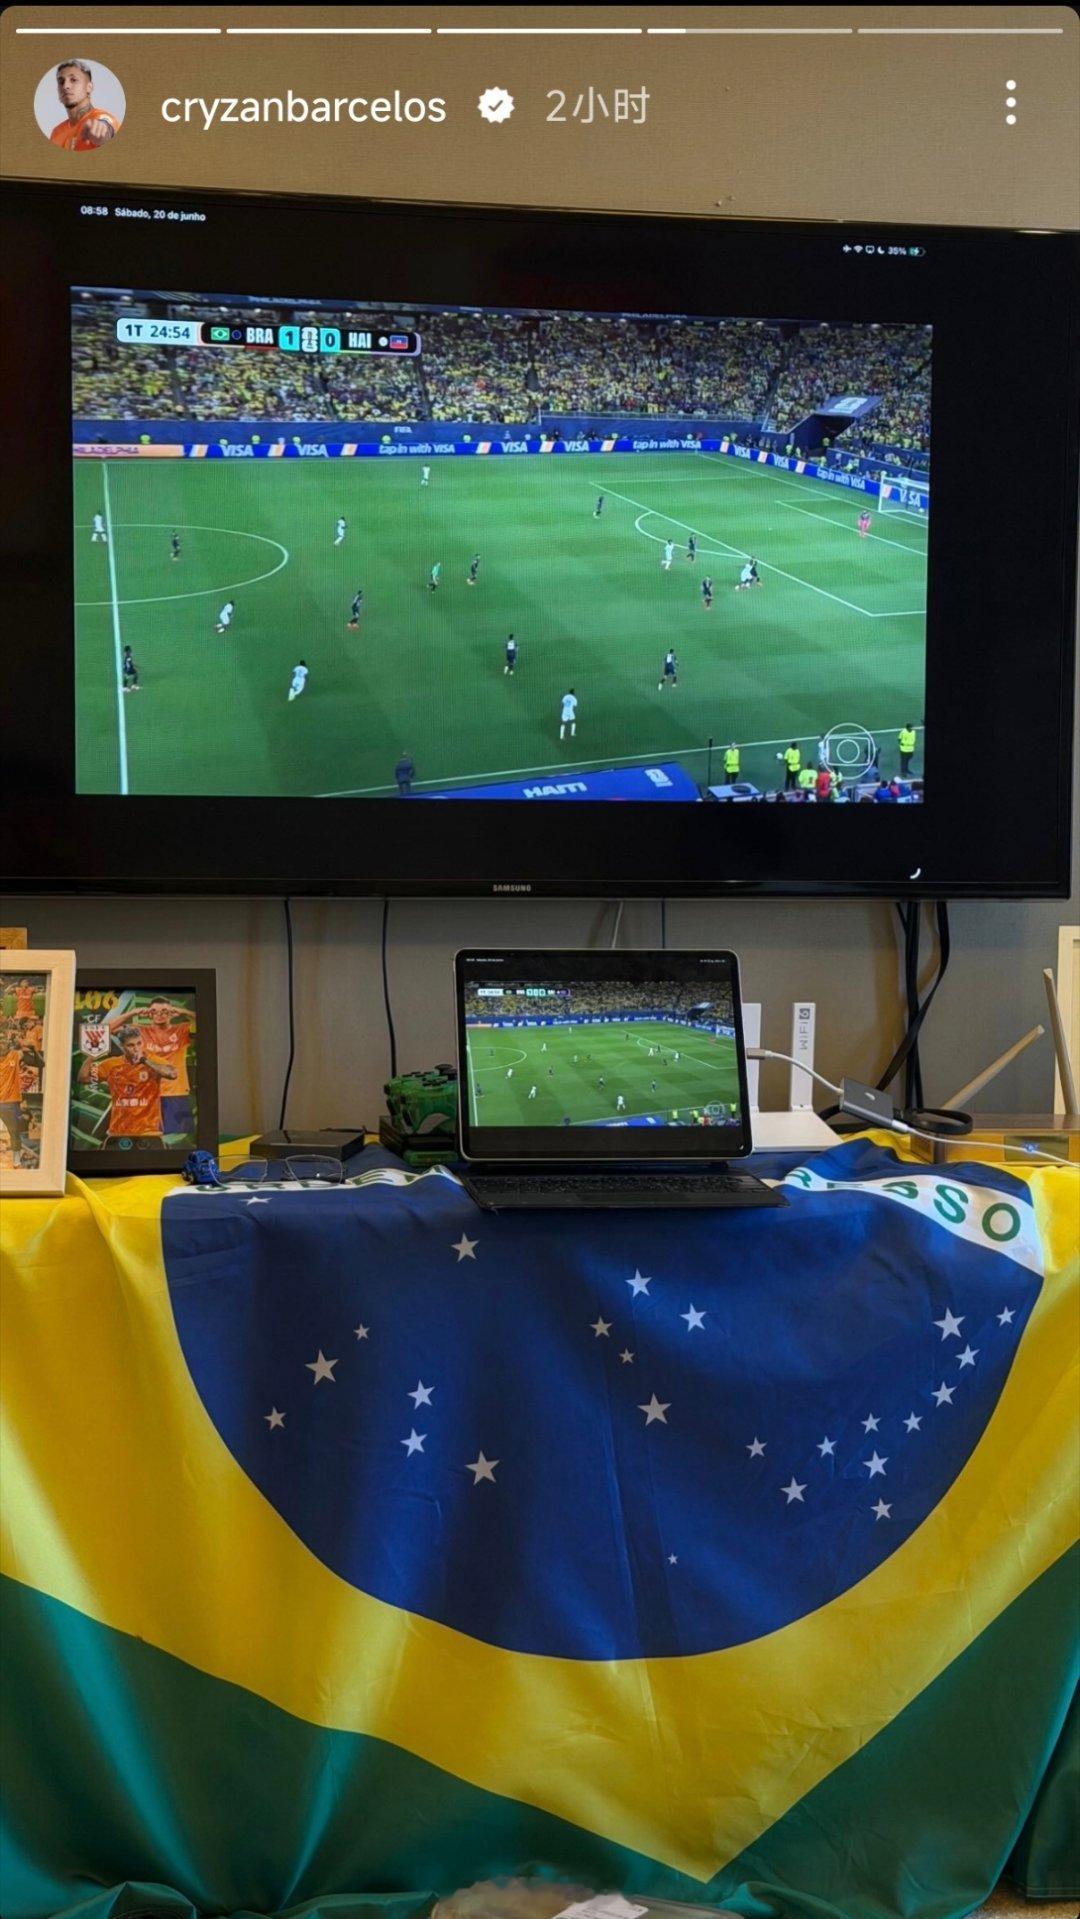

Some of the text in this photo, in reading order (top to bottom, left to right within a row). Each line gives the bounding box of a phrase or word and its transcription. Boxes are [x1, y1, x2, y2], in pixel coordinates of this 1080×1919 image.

[81, 206, 206, 221] 08:58 Sábado, 20 de junho
[888, 246, 907, 255] 35%
[125, 324, 372, 348] 1T 24:54 BRA 1 0 HAI
[220, 444, 254, 456] VISA
[295, 443, 329, 457] VISA
[433, 444, 455, 453] VISA
[501, 441, 528, 453] VISA
[564, 441, 590, 452] VISA
[633, 440, 648, 450] tap
[660, 440, 679, 449] with
[681, 440, 702, 449] VISA
[734, 445, 750, 459] VISA
[774, 454, 789, 469] VISA
[850, 476, 866, 490] VISA
[899, 489, 921, 507] VSA
[492, 884, 532, 892] SAMSUNG
